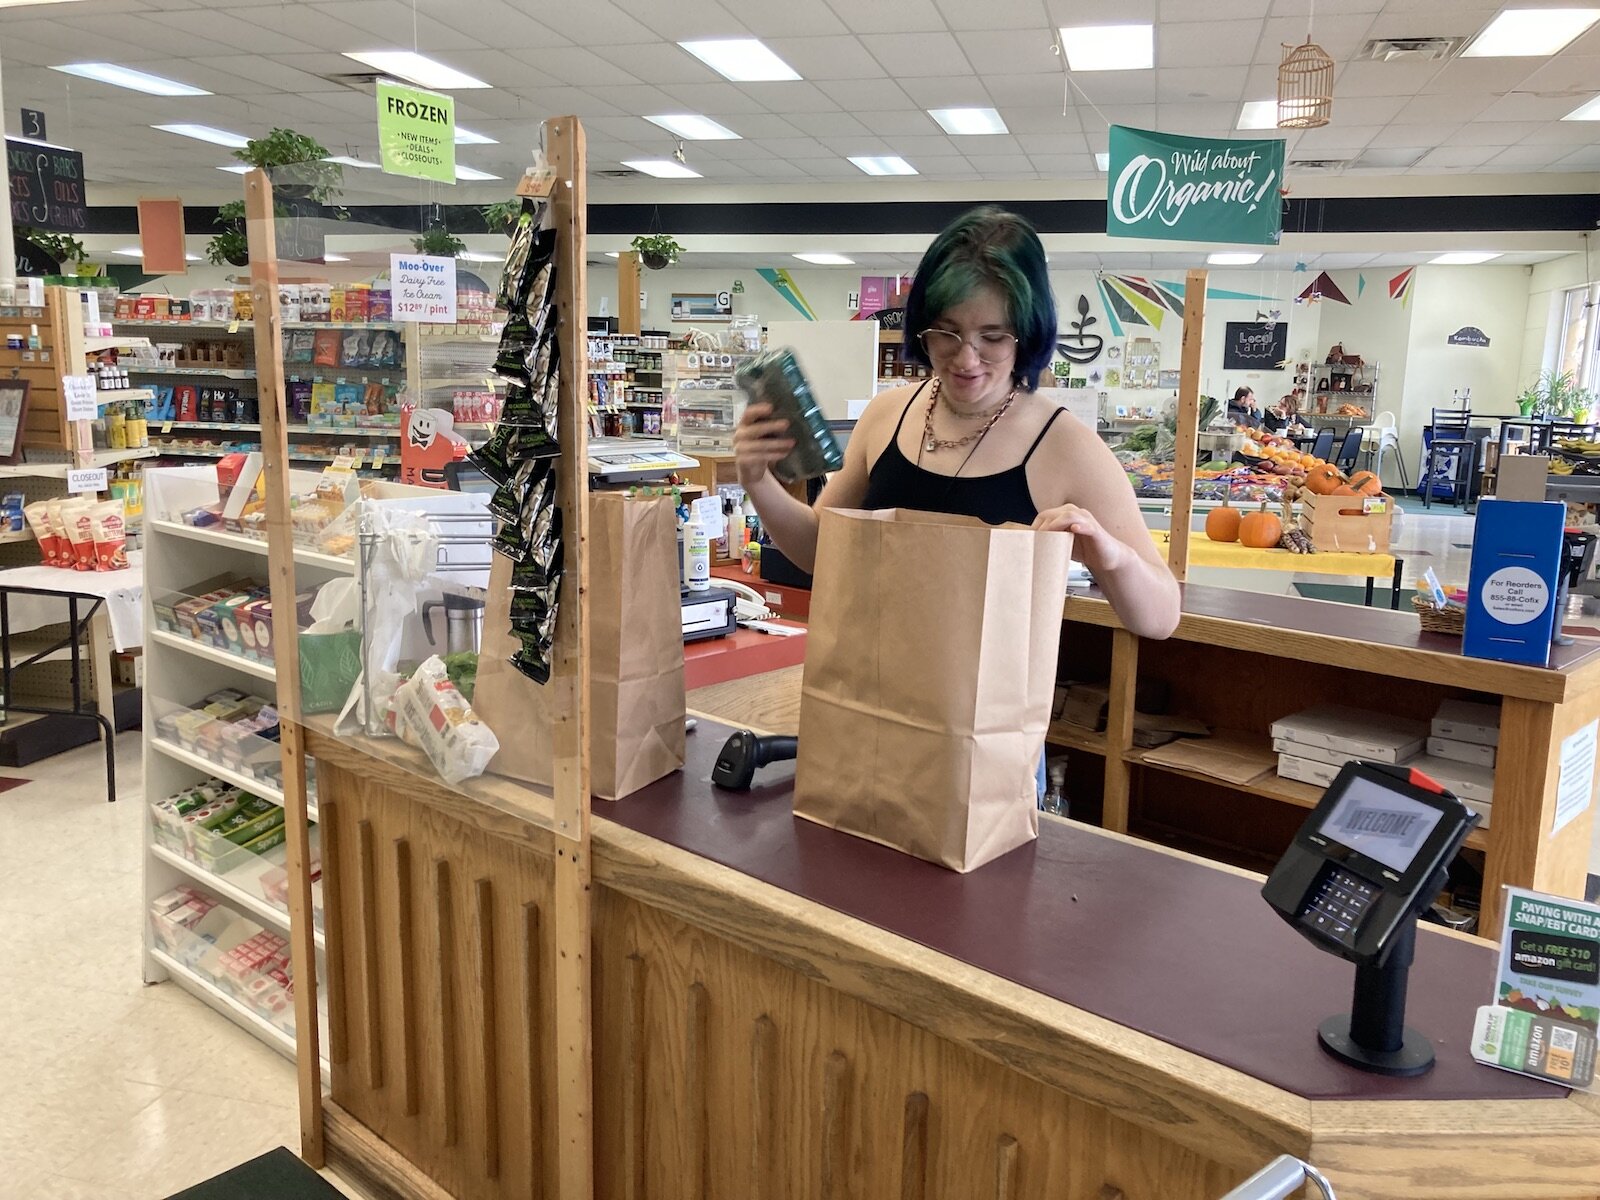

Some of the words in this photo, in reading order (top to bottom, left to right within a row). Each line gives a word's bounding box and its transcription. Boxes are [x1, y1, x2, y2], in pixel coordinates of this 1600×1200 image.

[387, 96, 448, 126] FROZEN
[28, 112, 40, 136] 3
[401, 131, 418, 142] NEW
[420, 135, 438, 146] ITEMS
[409, 143, 430, 154] DEALS
[401, 151, 440, 166] CLOSEOUTS
[1170, 149, 1209, 176] Wild
[1211, 148, 1261, 173] about
[53, 155, 78, 180] BARS
[54, 180, 79, 204] OILS
[1111, 154, 1276, 227] Organic!
[399, 260, 445, 272] Moo-Over
[400, 274, 426, 288] Dairy
[427, 275, 445, 286] Free
[402, 288, 415, 298] Ice
[416, 288, 443, 300] Cream
[718, 291, 729, 306] G
[848, 293, 859, 308] H
[430, 304, 448, 316] pint
[1239, 331, 1273, 344] Local
[1243, 342, 1268, 352] art
[180, 389, 191, 415] UNREAL
[72, 472, 104, 483] CLOSEOUT
[1506, 581, 1542, 589] Reorders
[1490, 594, 1539, 603] 855-88-Cofix
[1347, 810, 1415, 836] WELCOME
[1521, 901, 1561, 919] PAYING
[1562, 910, 1592, 925] WITH
[1515, 911, 1568, 931] SNAP/EBT
[1520, 940, 1536, 950] Get
[1544, 944, 1570, 956] FREE
[1570, 947, 1591, 959] $10
[1514, 952, 1556, 967] amazon
[1556, 957, 1572, 969] gift
[1573, 961, 1597, 973] card!
[1555, 985, 1584, 998] SURVEY
[1527, 1025, 1544, 1067] amazon
